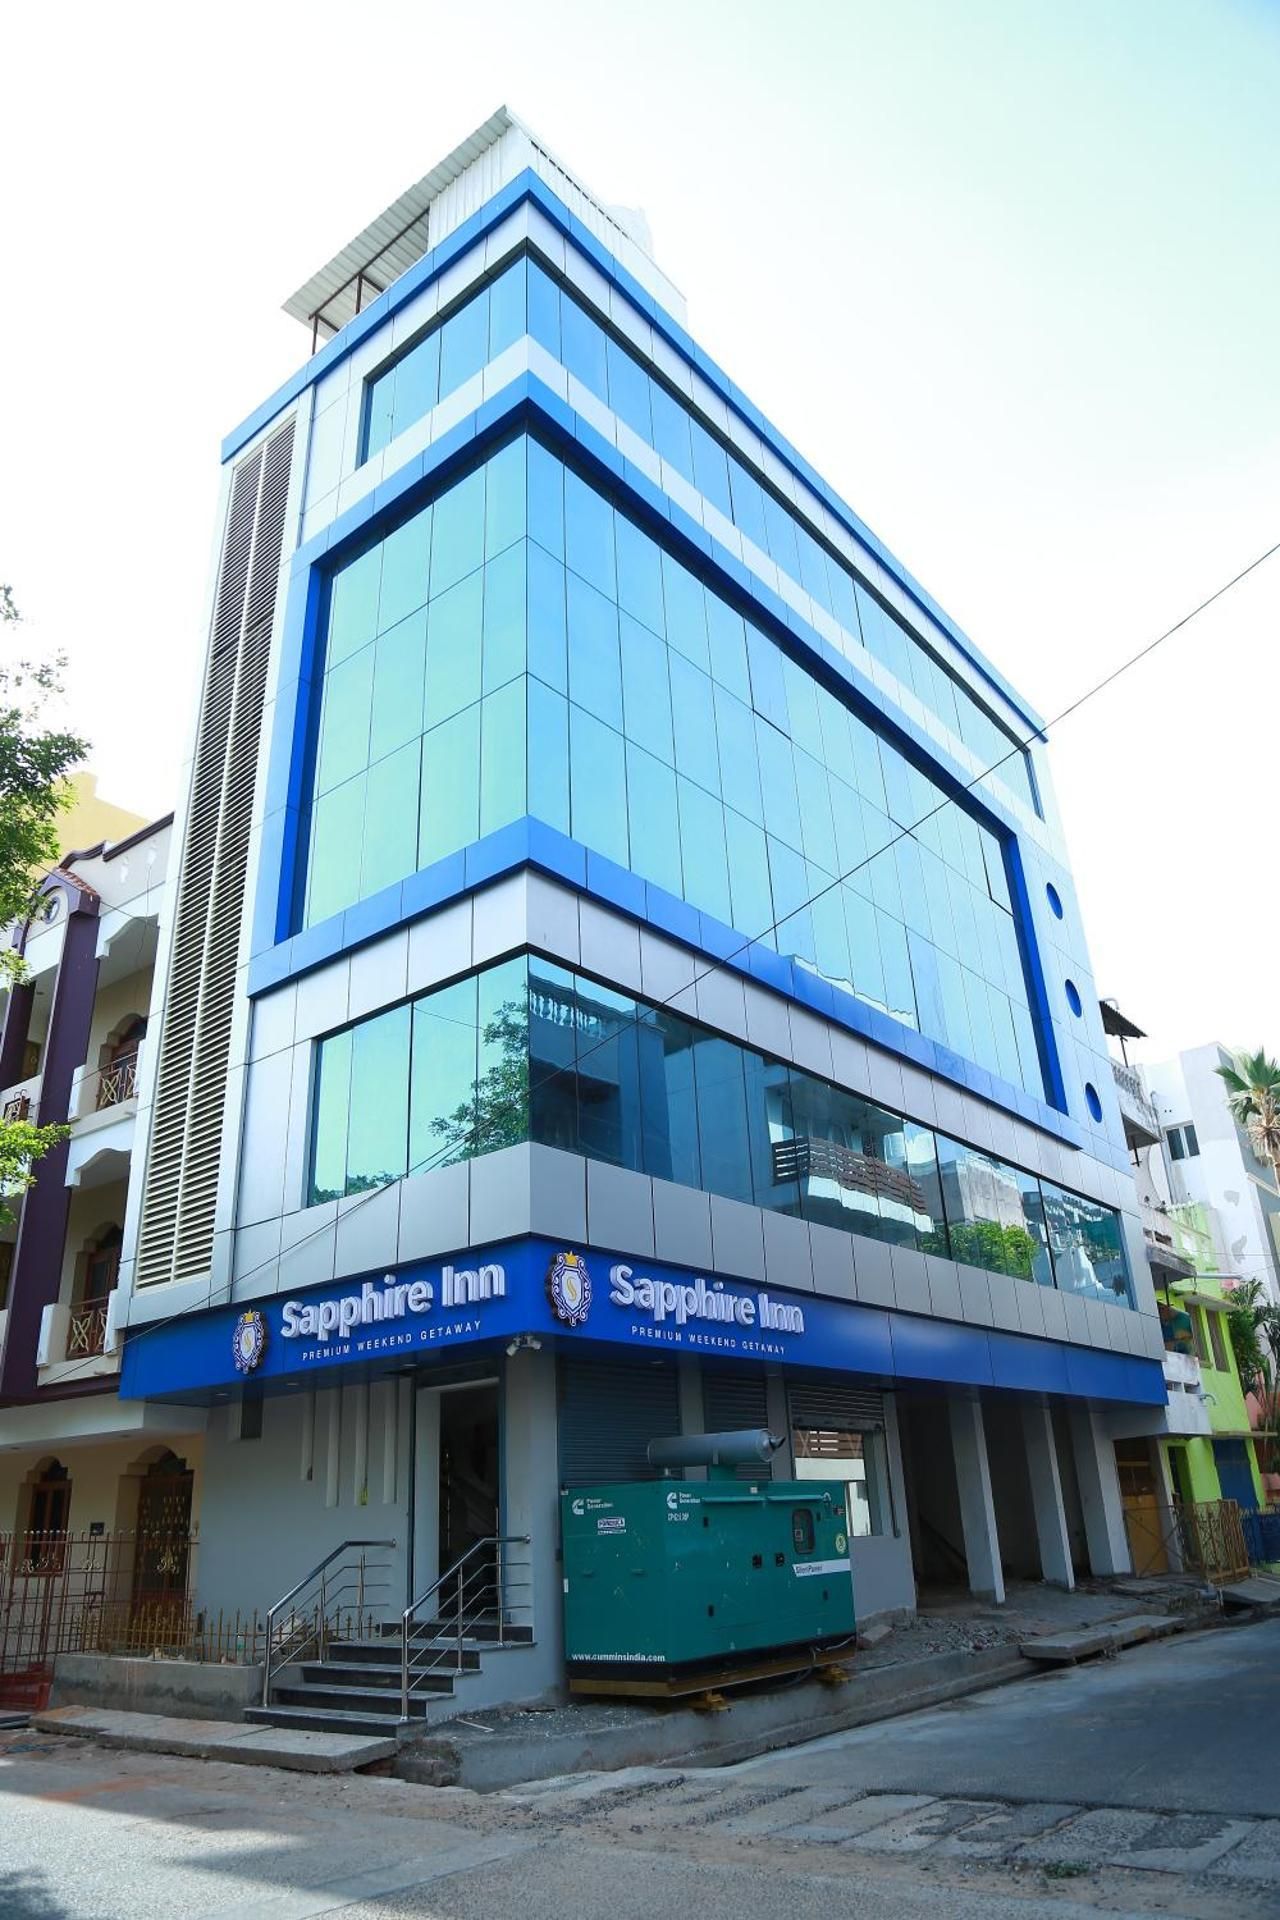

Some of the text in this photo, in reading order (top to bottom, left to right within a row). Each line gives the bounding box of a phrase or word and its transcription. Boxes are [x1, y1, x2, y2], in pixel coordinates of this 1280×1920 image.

[280, 1263, 506, 1341] Sapphire Inn
[609, 1264, 805, 1334] Sapphire Inn
[302, 1320, 482, 1361] PREMIUM WEEKEND GETAWAY
[631, 1325, 785, 1355] PREMIUM WEEKEND GETAWAY
[571, 1652, 666, 1662] www.cumminsindia.com
